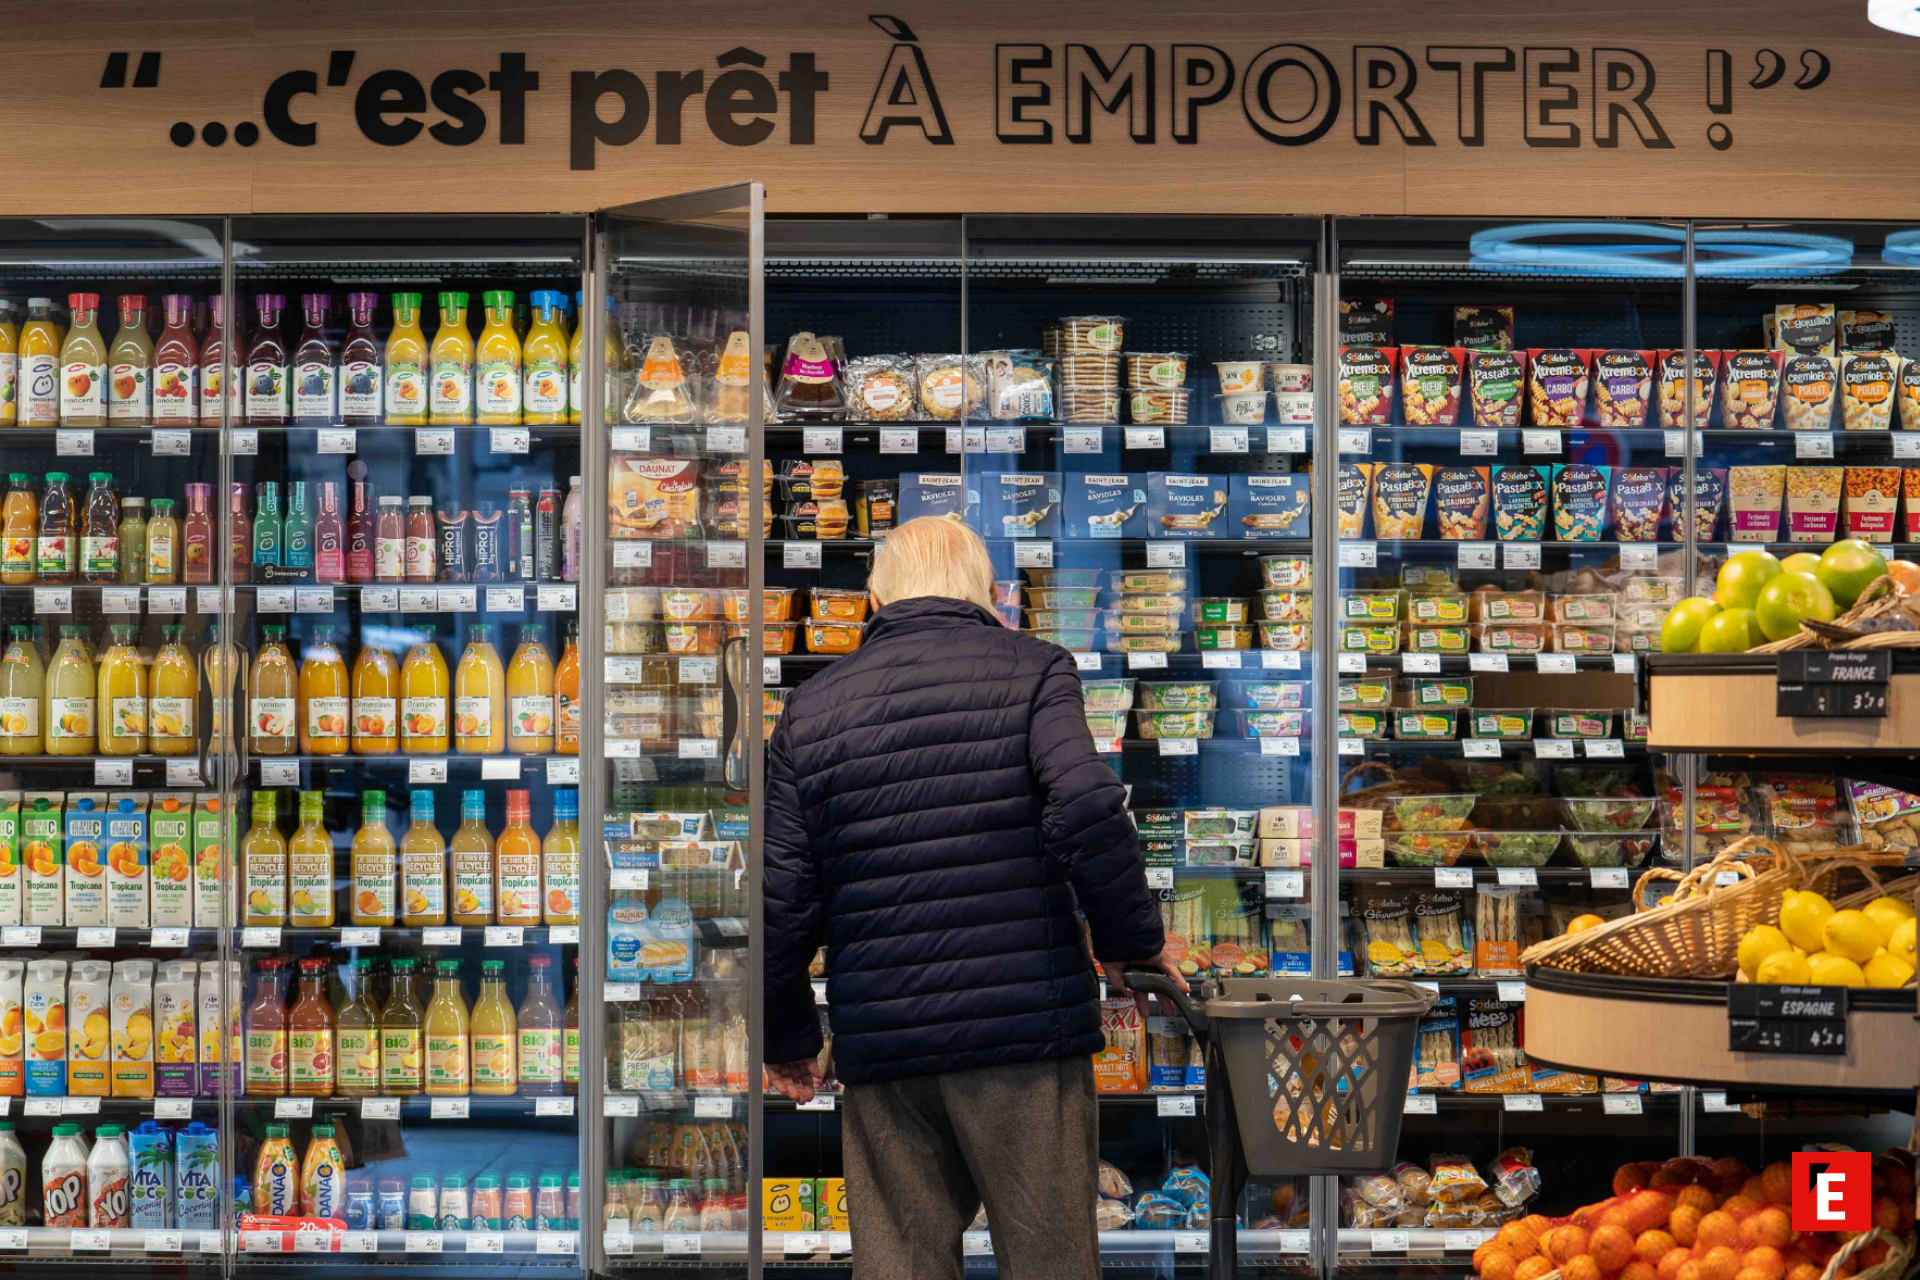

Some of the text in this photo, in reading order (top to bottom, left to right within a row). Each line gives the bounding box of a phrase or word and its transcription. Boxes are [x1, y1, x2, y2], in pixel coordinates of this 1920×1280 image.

[569, 46, 830, 170] prêt
[859, 14, 954, 145] À
[994, 43, 1676, 150] EMPORTER
[1415, 352, 1441, 362] Sodebo
[1542, 354, 1568, 363] Sodebo
[1737, 357, 1763, 366] Sodebo
[1479, 358, 1505, 367] Sodebo
[1795, 361, 1821, 370] Sodebo
[1853, 361, 1880, 370] Sodebo
[1354, 381, 1375, 392] BŒUF
[1421, 381, 1443, 392] BŒUF
[1546, 383, 1572, 394] CARBO
[1798, 385, 1825, 395] POULET
[1857, 385, 1884, 395] POULET
[639, 464, 676, 473] DAUNAT
[1385, 471, 1412, 480] Sodebo
[1441, 472, 1469, 481] Sodebo
[1501, 471, 1529, 481] Sodebo
[1562, 471, 1589, 481] Sodebo
[921, 490, 956, 501] RAVIOLES
[1002, 490, 1036, 500] RAVIOLES
[1087, 490, 1122, 501] RAVIOLES
[1446, 497, 1476, 506] SAUMON
[1832, 666, 1876, 680] FRANCE
[64, 701, 88, 709] Citrons
[257, 701, 286, 709] Pommes
[407, 700, 436, 709] Oranges
[522, 700, 551, 708] Oranges
[1146, 814, 1170, 823] Sodebo
[1147, 842, 1172, 851] Sodebo
[26, 880, 58, 890] Tropicana
[249, 876, 285, 887] Tropicana
[292, 877, 328, 887] Tropicana
[357, 877, 393, 887] Tropicana
[405, 875, 441, 886] Tropicana
[455, 875, 492, 885] Tropicana
[500, 877, 537, 888] Tropicana
[69, 881, 102, 891] Tropicana
[110, 881, 143, 891] Tropicana
[154, 882, 186, 891] Tropicana
[1419, 895, 1453, 903] Sodebo
[1469, 1000, 1508, 1011] Sodebo
[1782, 1001, 1835, 1016] ESPAGNE
[1102, 1007, 1143, 1029] XXL
[1469, 1012, 1508, 1028] Méga
[385, 1038, 410, 1048] BIO
[1120, 1051, 1135, 1062] x3
[130, 1169, 161, 1185] VITA
[179, 1170, 212, 1187] VITA
[177, 1186, 216, 1200] COCO
[271, 1163, 286, 1216] DANAO
[319, 1162, 333, 1218] DANAO
[44, 1175, 81, 1219] YOP
